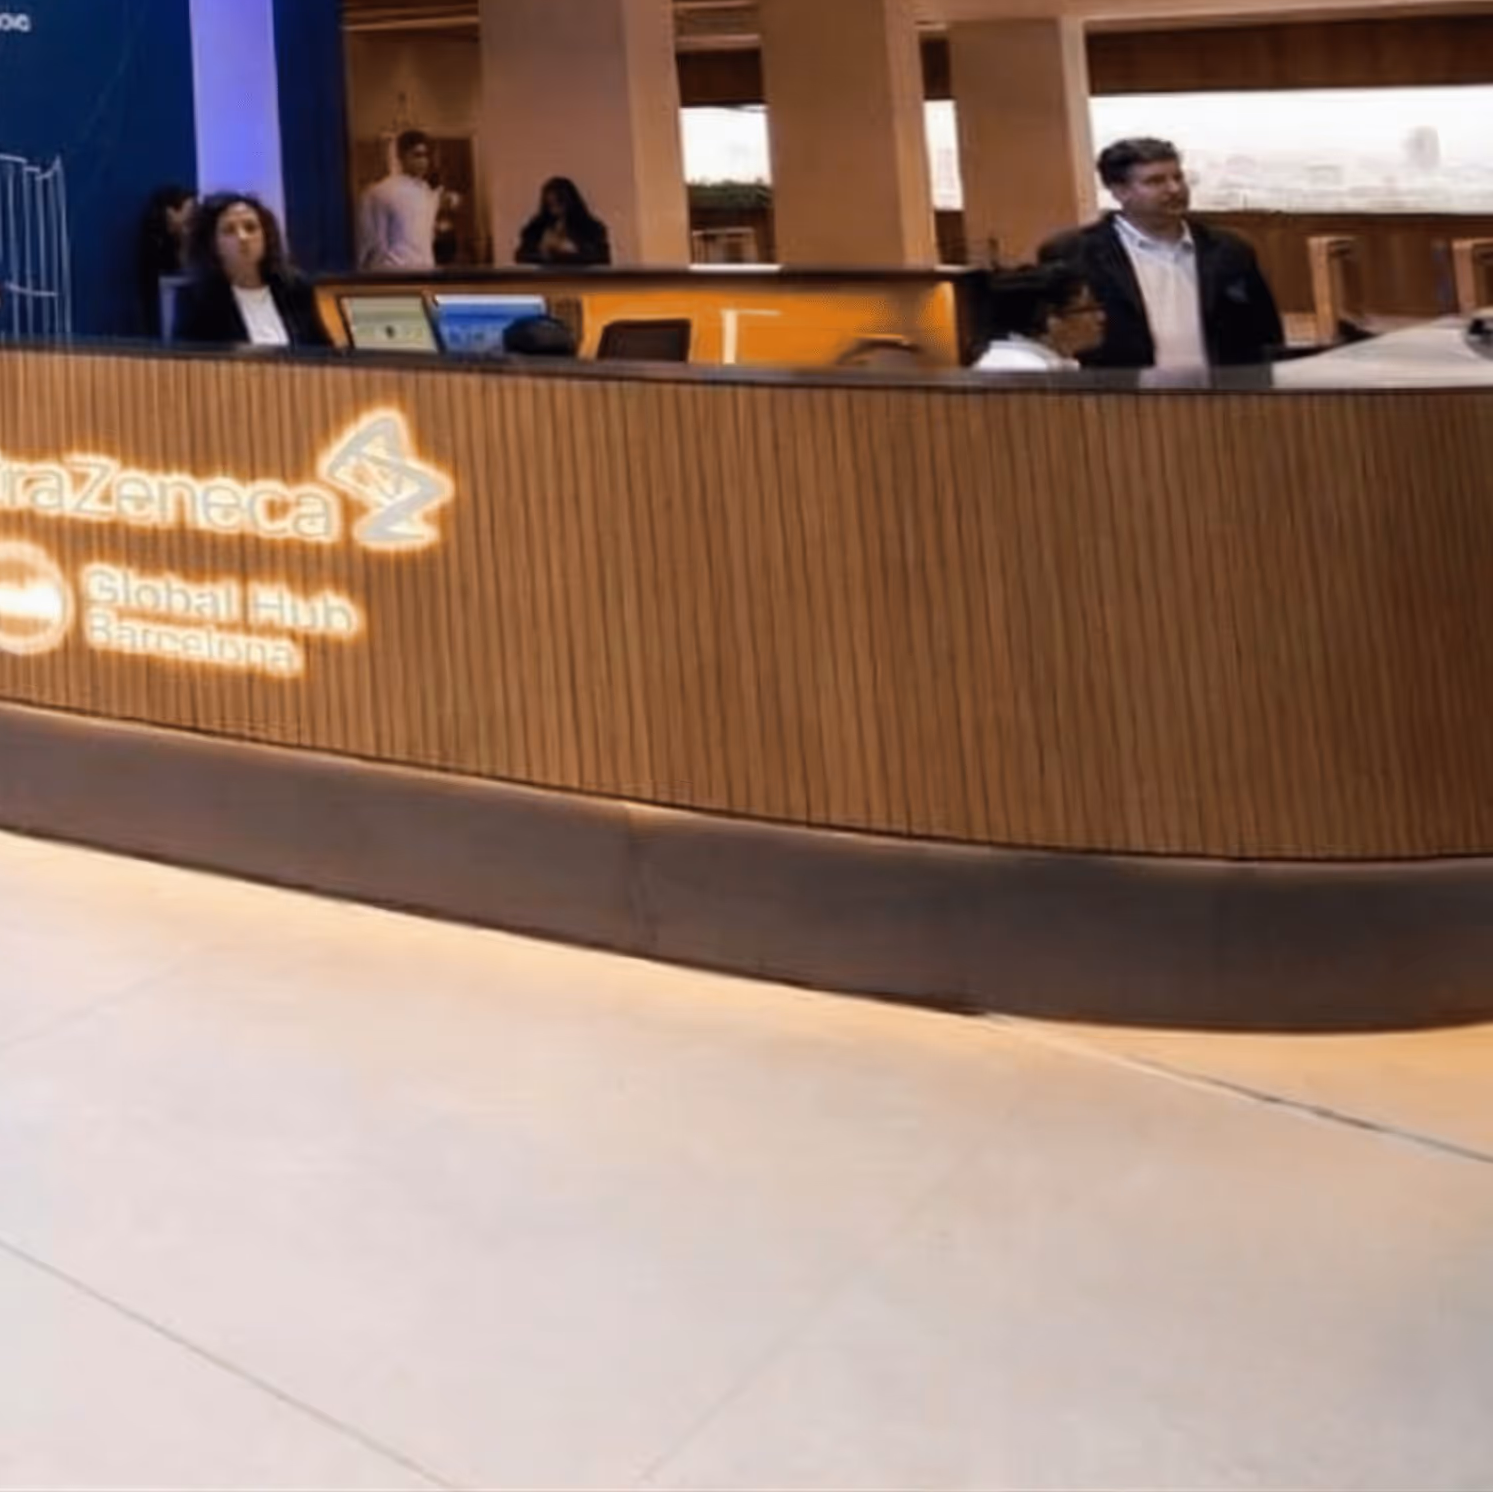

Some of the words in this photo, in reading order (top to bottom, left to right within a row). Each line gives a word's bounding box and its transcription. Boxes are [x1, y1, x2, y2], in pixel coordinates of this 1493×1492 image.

[86, 565, 239, 622] Global
[247, 583, 363, 638] Hub
[87, 609, 303, 676] Barcelona
